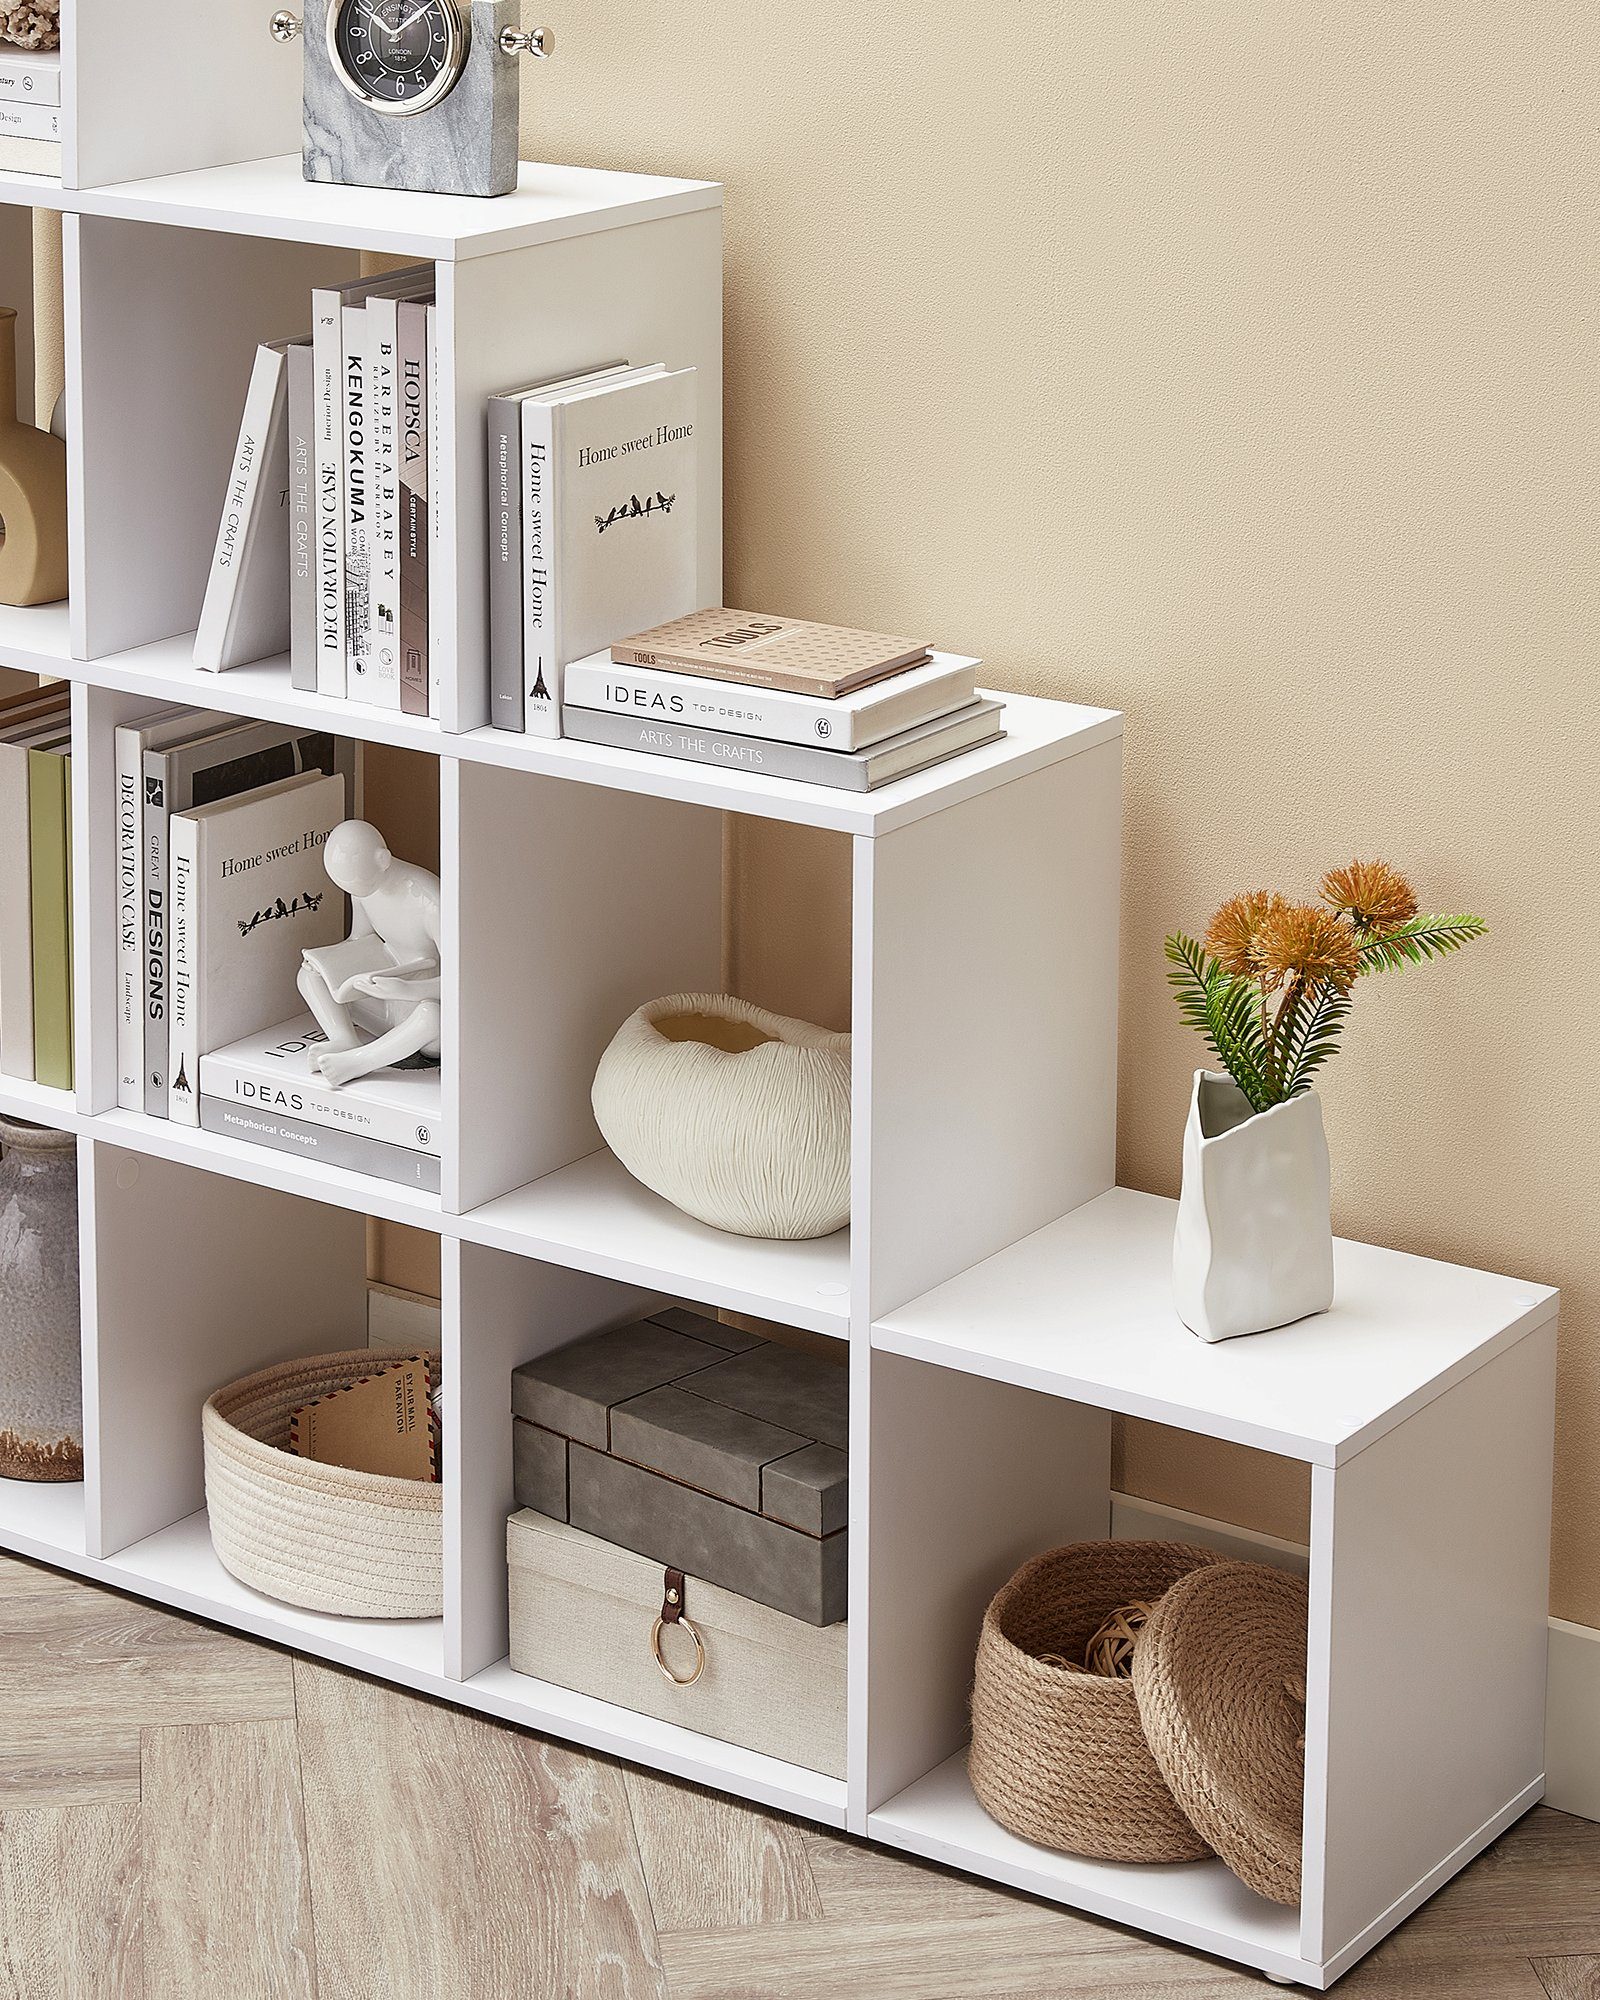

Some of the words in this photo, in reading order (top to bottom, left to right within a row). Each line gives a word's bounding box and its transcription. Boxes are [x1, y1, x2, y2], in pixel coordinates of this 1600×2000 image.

[350, 26, 367, 38] 9
[433, 32, 446, 43] 3
[356, 51, 373, 64] 8
[373, 67, 388, 85] 7
[429, 55, 443, 71] 4
[395, 75, 405, 95] 6
[414, 69, 427, 90] 5
[323, 368, 331, 401] Design
[323, 404, 331, 441] Interior
[404, 358, 421, 464] HOPSCA
[239, 434, 255, 473] ARTS
[296, 435, 307, 475] ARTS
[348, 355, 365, 523] KENGOKUMA
[578, 446, 618, 468] Home
[621, 434, 654, 457] sweet
[656, 424, 693, 446] Home
[322, 462, 336, 513] CASE
[499, 434, 509, 507] Metaphorical
[530, 442, 546, 504] Home
[231, 480, 248, 508] THE
[296, 483, 307, 513] THE
[219, 513, 240, 568] CRAFTS
[296, 520, 308, 578] CRAFTS
[501, 511, 510, 562] Concepts
[531, 510, 543, 562] sweet
[322, 516, 337, 649] DECORATION
[532, 568, 547, 629] Home
[699, 622, 783, 649] TOOLS
[378, 672, 395, 680] BOOK
[633, 652, 656, 665] TOOLS
[606, 684, 684, 713] IDEAS
[693, 703, 715, 713] TOP
[719, 707, 763, 722] DESIGN
[639, 729, 673, 747] ARTS
[678, 736, 706, 754] THE
[712, 743, 763, 764] CRAFTS
[121, 773, 136, 902] DECORATION
[221, 853, 263, 879] Home
[265, 839, 300, 864] sweet
[302, 828, 334, 850] Hom
[150, 835, 160, 881] GREAT
[176, 856, 190, 912] Home
[121, 904, 136, 952] CASE
[177, 916, 187, 965] sweet
[148, 889, 164, 1020] DESIGNS
[124, 972, 133, 1024] Landscape
[176, 970, 191, 1027] Home
[264, 1030, 329, 1058] IDE
[235, 1079, 303, 1110] IDEAS
[310, 1102, 331, 1113] TOP
[333, 1109, 372, 1125] DESIGN
[223, 1112, 277, 1136] Metaphorical
[280, 1128, 318, 1146] Concepts
[395, 1380, 403, 1401] PAR
[405, 1373, 413, 1385] BY
[395, 1403, 404, 1434] AVION
[407, 1407, 416, 1432] MAIL
